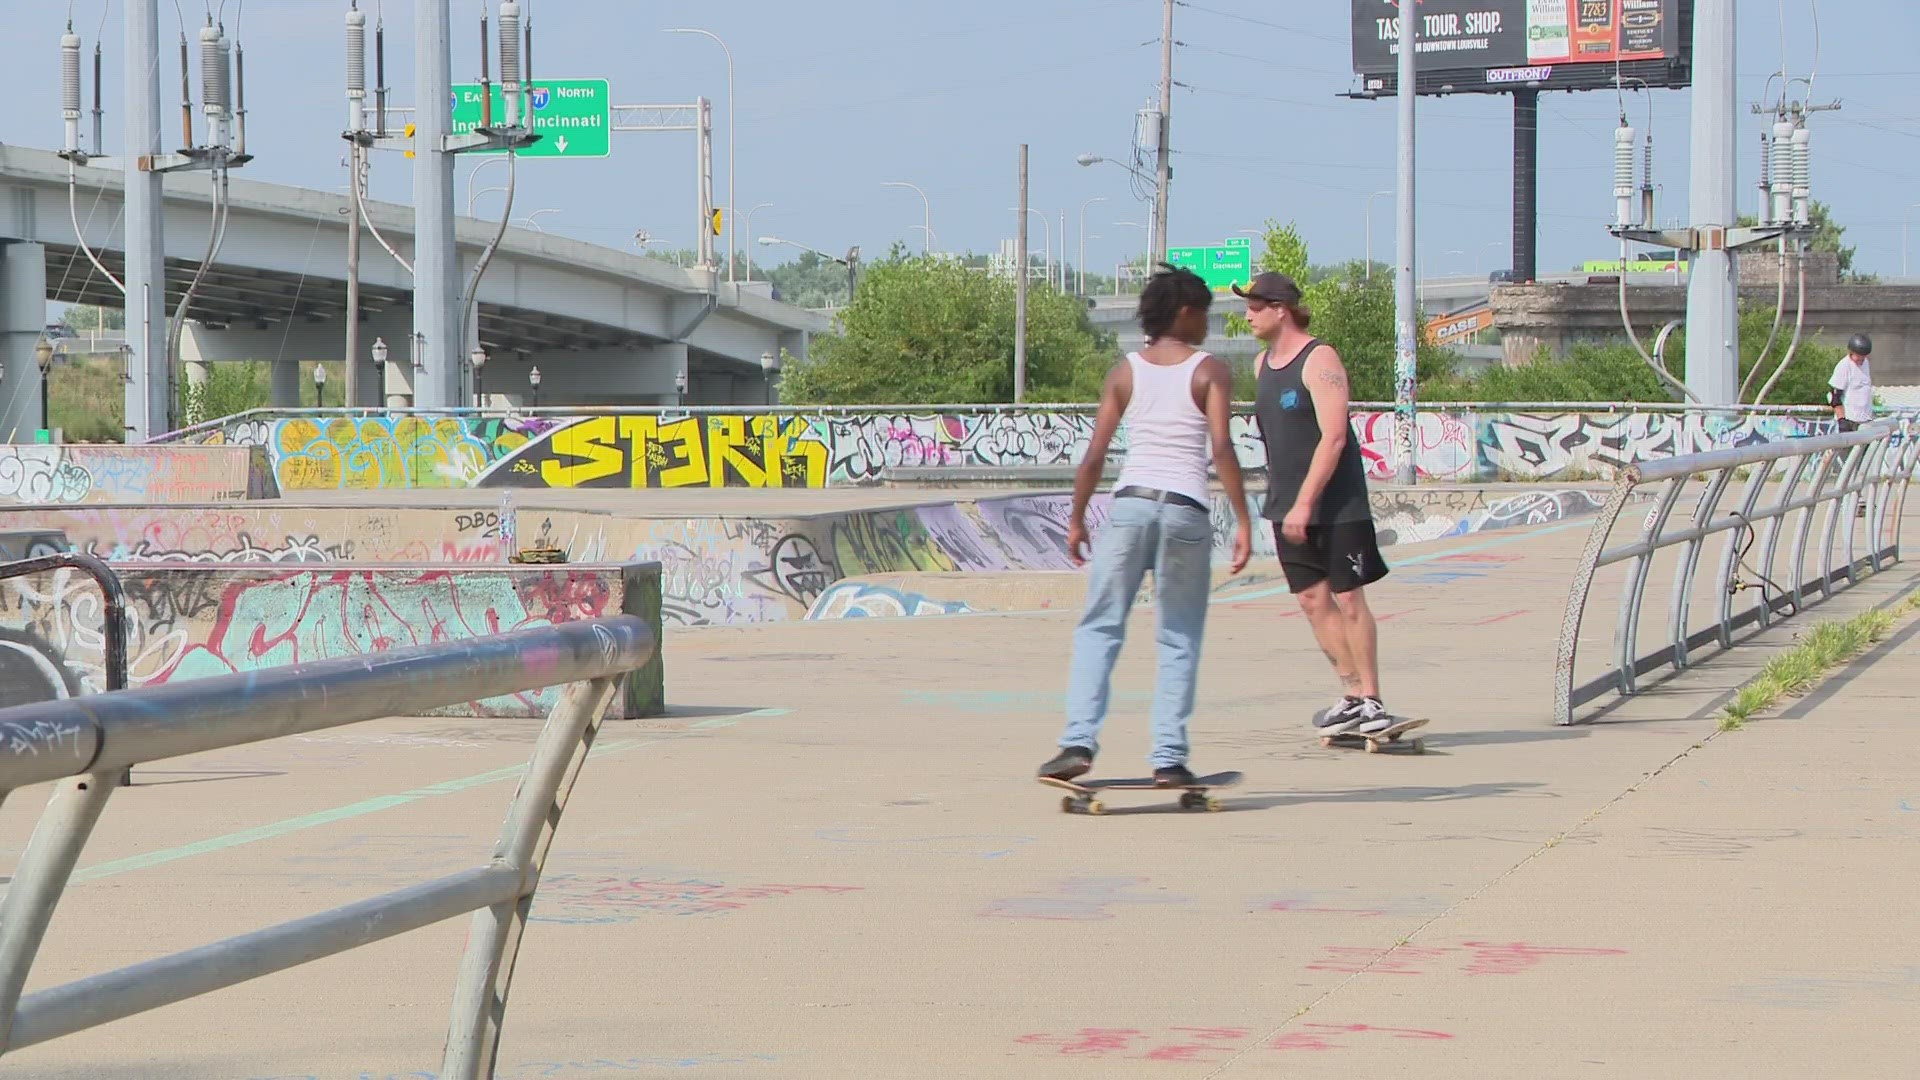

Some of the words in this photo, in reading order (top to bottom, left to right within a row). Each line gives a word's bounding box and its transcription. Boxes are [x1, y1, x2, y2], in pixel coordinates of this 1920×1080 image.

[1531, 4, 1566, 13] Williams
[1581, 2, 1607, 18] 1783
[1376, 17, 1420, 40] TAS.
[1424, 14, 1461, 38] TOUR.
[1465, 11, 1502, 35] SHOP.
[1422, 40, 1457, 53] DOWNTOWN
[1457, 38, 1489, 51] LOUISVILLE
[533, 94, 544, 104] 71
[557, 87, 594, 98] NORTH
[1437, 316, 1478, 339] CASE
